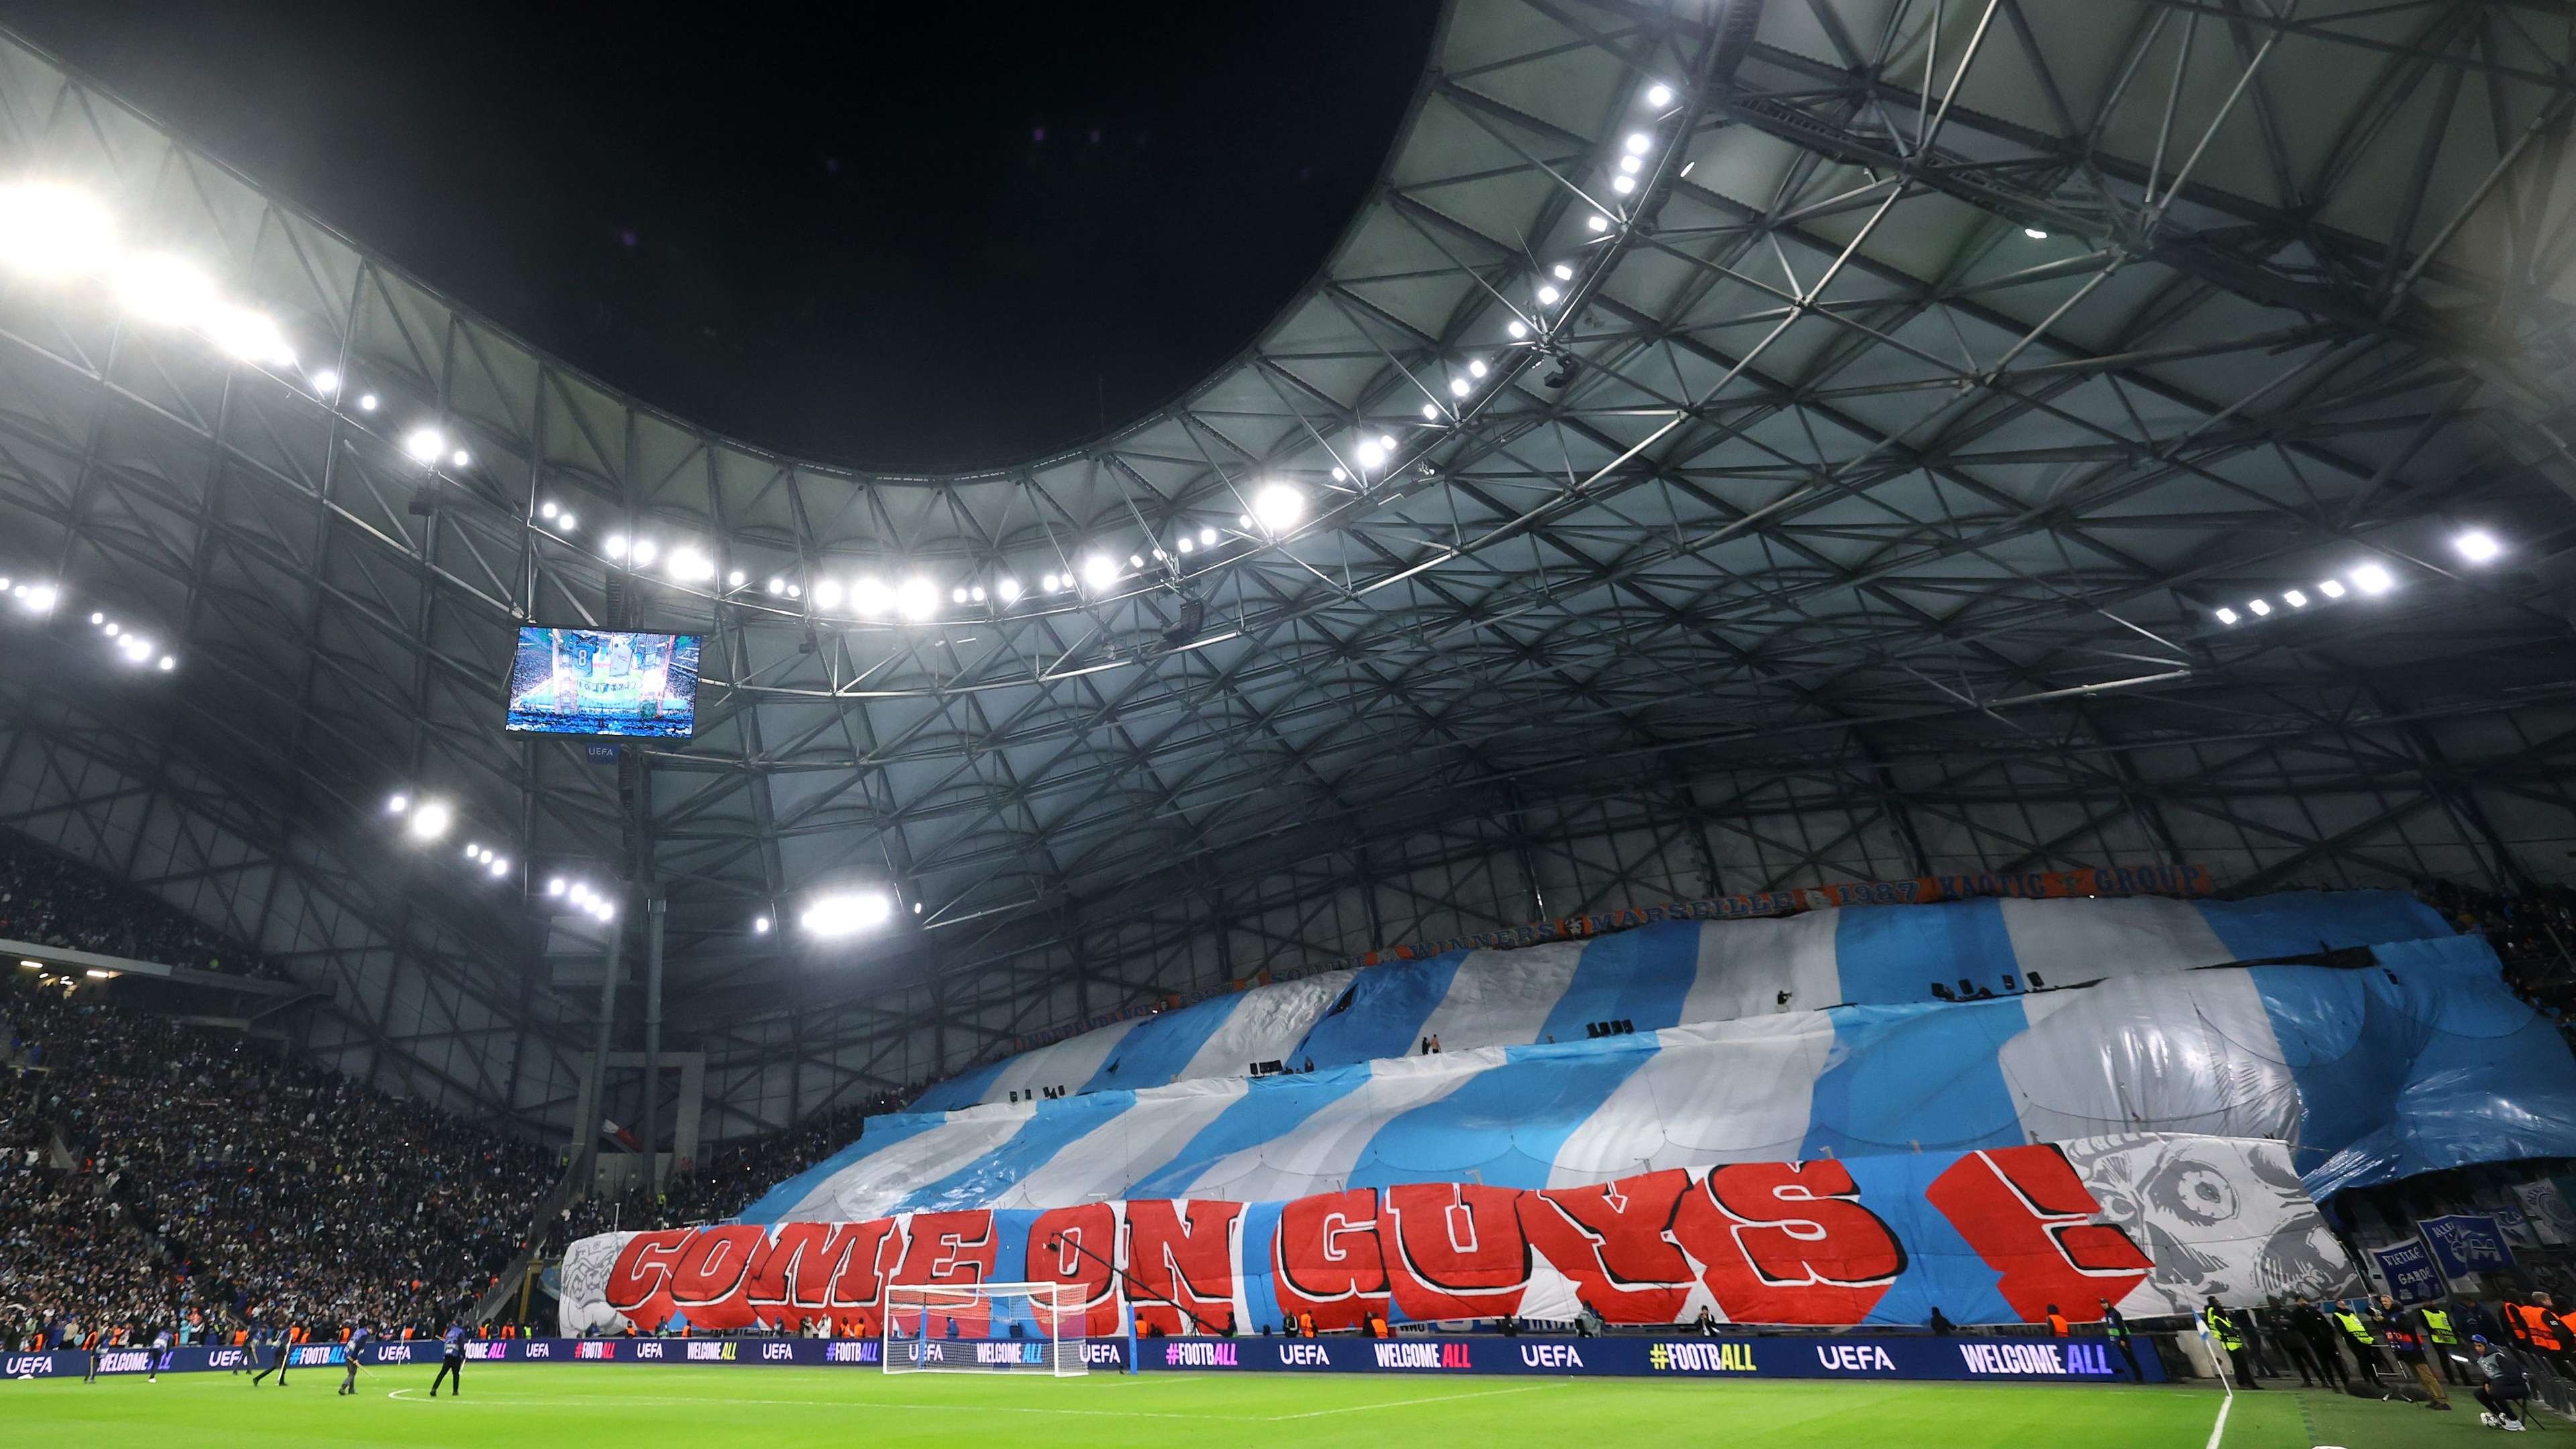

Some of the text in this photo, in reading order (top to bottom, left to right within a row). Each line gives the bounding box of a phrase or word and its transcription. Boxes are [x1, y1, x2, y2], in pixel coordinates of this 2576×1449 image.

[588, 747, 613, 756] UEFA
[1591, 892, 1793, 931] MARSEILLE
[605, 1142, 2156, 1335] COME ON GUYS !
[378, 1345, 411, 1361] UEFA
[487, 1342, 507, 1359] ALL
[526, 1342, 549, 1358] UEFA
[574, 1342, 617, 1359] #FOOTBALL
[637, 1342, 663, 1358] UEFA
[687, 1342, 737, 1360] WELCOME ALL
[763, 1343, 793, 1360] UEFA
[826, 1342, 879, 1362] #FOOTBALL
[976, 1342, 1044, 1364] WELCOME ALL
[1079, 1344, 1121, 1363] UEFA
[1165, 1342, 1238, 1366] #FOOTBALL
[1279, 1344, 1330, 1366] UEFA
[1374, 1342, 1472, 1368] WELCOME ALL
[1521, 1344, 1584, 1368] UEFA
[1650, 1342, 1758, 1372] #FOOTBALL
[1816, 1345, 1896, 1371] UEFA
[1958, 1344, 2114, 1375] WELCOME ALL
[5, 1356, 52, 1374] UEFA
[97, 1350, 174, 1372] WELCOME LL
